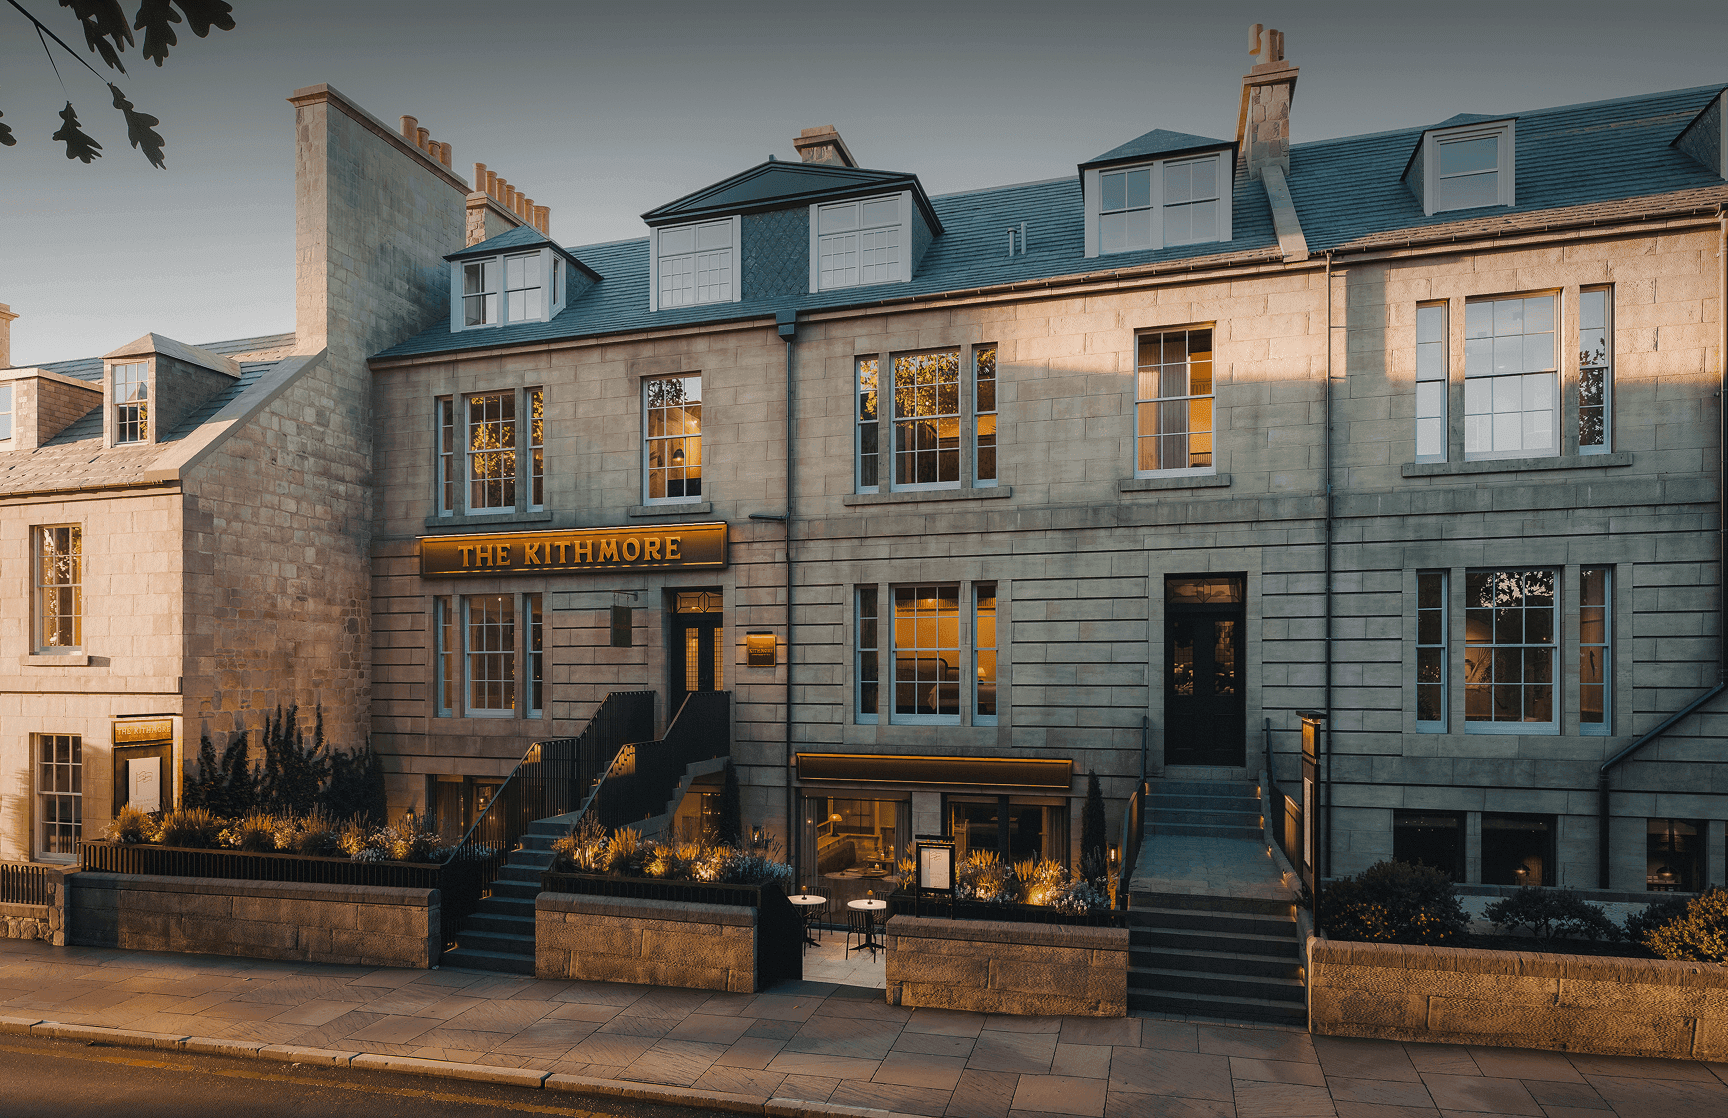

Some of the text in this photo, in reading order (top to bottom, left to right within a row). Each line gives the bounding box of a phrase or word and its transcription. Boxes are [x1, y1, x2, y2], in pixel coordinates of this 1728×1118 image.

[457, 536, 682, 567] THE KITHMORE
[116, 727, 131, 736] THE
